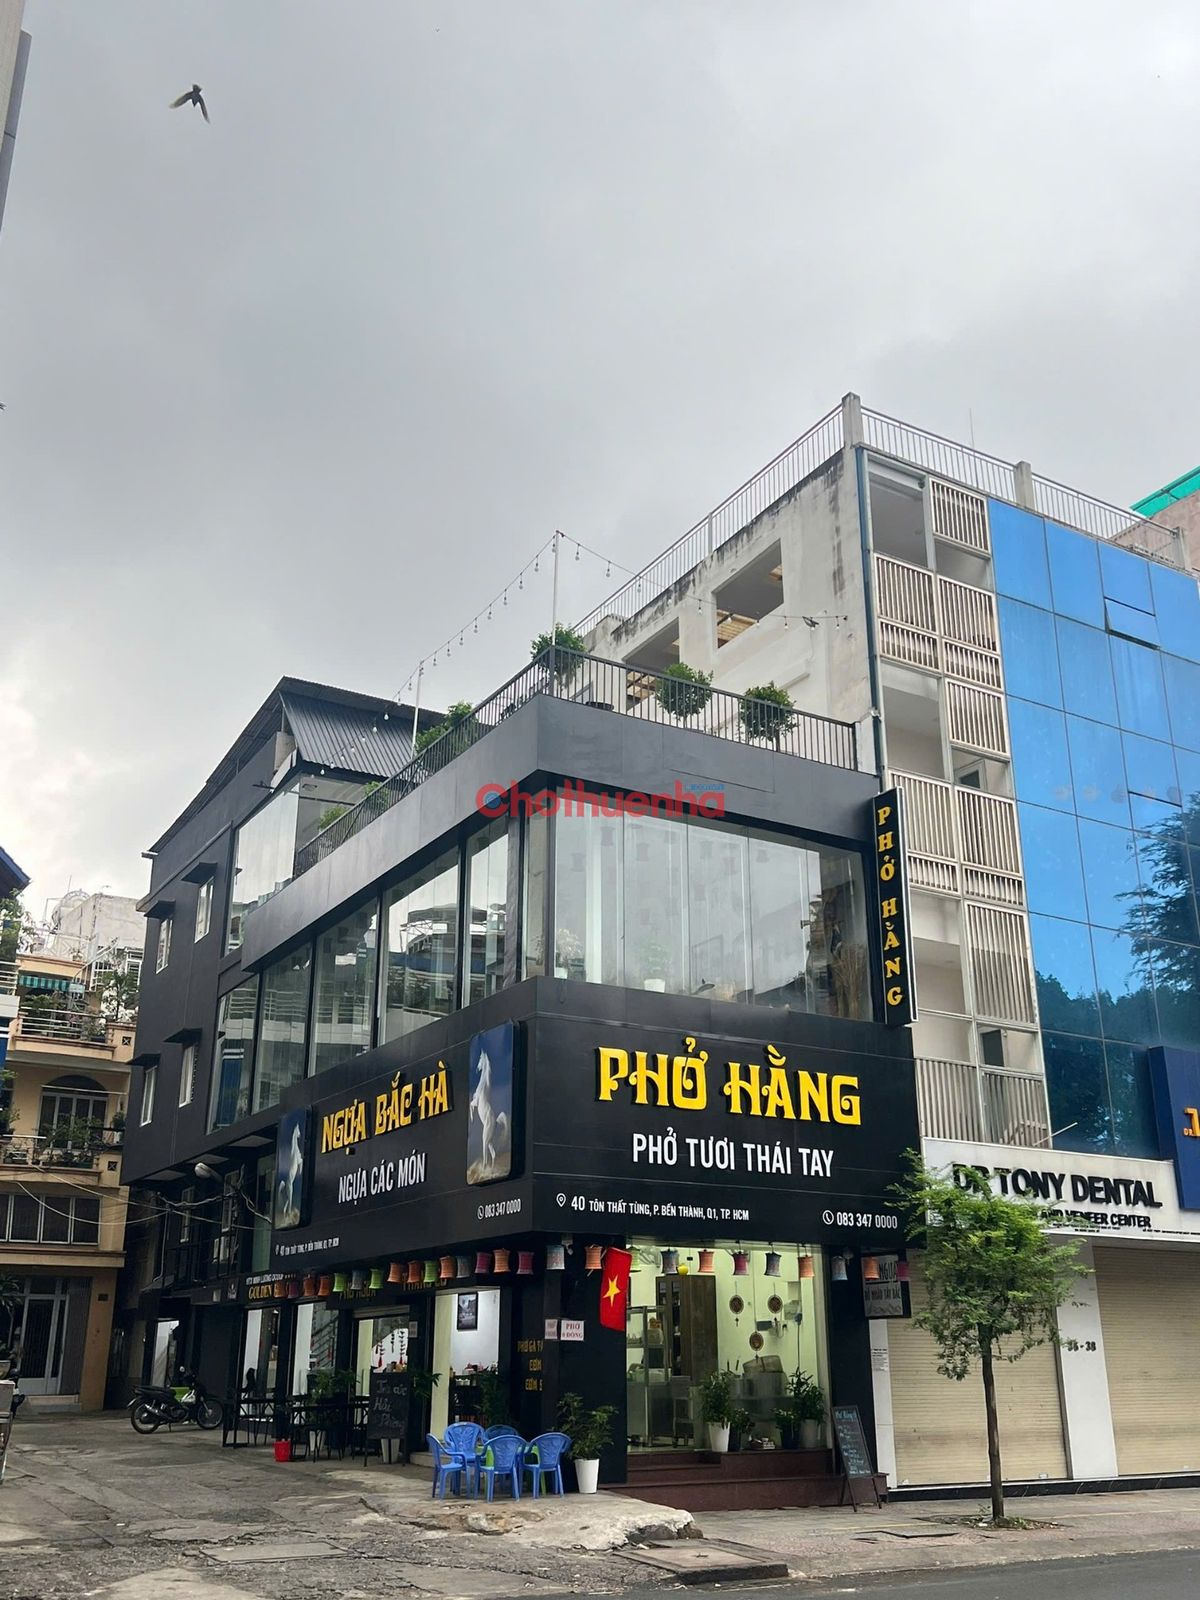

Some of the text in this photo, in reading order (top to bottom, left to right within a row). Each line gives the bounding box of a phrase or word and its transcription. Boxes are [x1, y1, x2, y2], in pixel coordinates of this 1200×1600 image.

[878, 806, 903, 1006] PHỞ HẰNG
[597, 1037, 862, 1126] PHỞ HẰNG
[321, 1060, 449, 1155] NGỰA BẮC HÀ
[632, 1126, 834, 1178] PHỞ TƯƠI THÁI TAY
[338, 1149, 426, 1206] NGỰA CÁC MÓN
[993, 1167, 1066, 1201] TONY
[1070, 1174, 1163, 1208] DENTAL
[485, 1198, 521, 1218] 083 347 0000
[571, 1196, 585, 1211] 40
[589, 1200, 605, 1212] TÔN
[606, 1199, 627, 1214] THẤT
[629, 1202, 652, 1216] TÙNG,
[653, 1204, 660, 1216] P.
[661, 1202, 676, 1216] BẾN
[678, 1204, 706, 1219] THÀNH,
[707, 1208, 718, 1220] Q1,
[733, 1209, 749, 1221] HCM
[836, 1212, 898, 1229] 083 347 0000
[1110, 1213, 1152, 1228] CENTER
